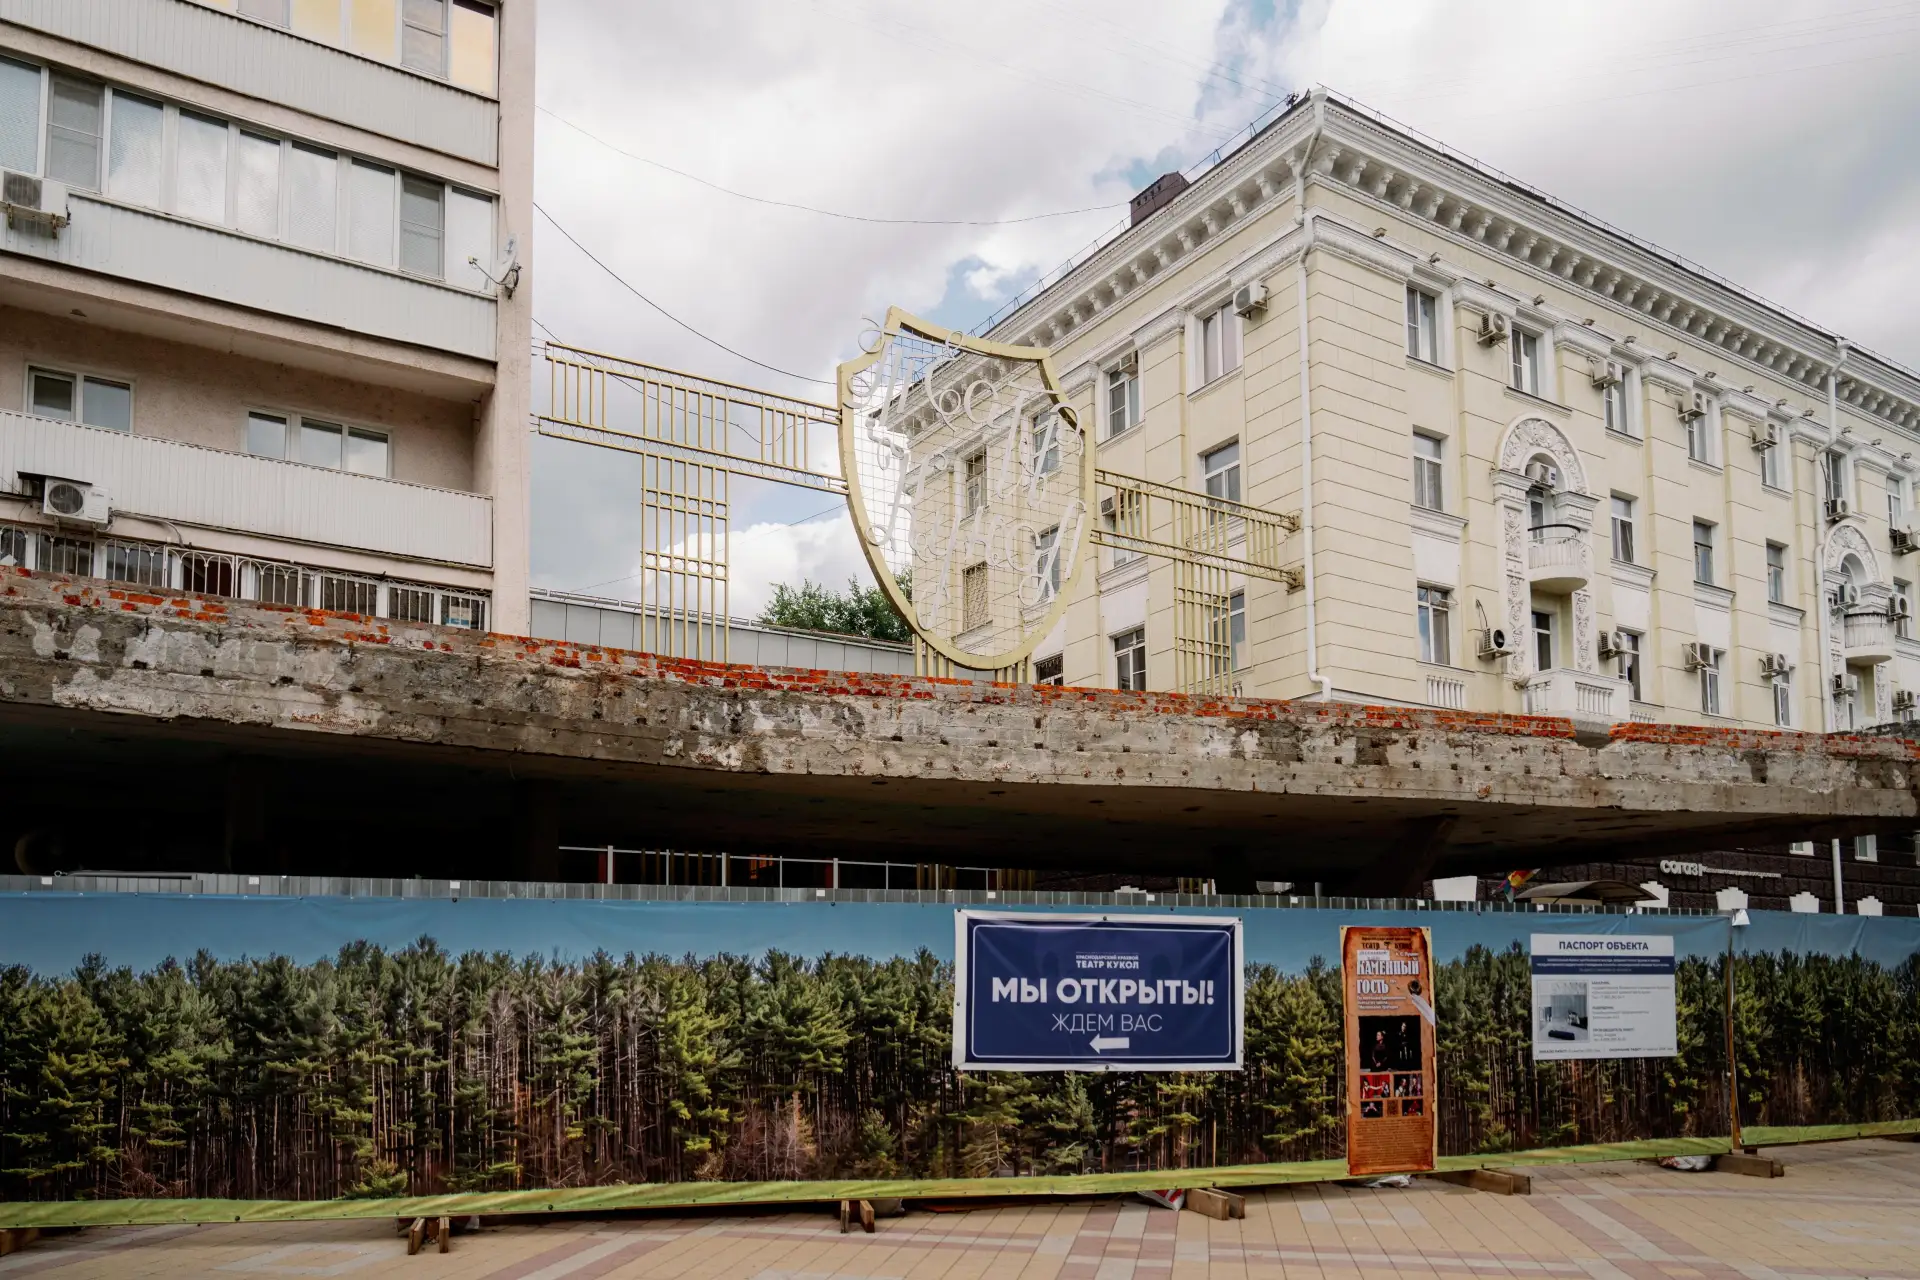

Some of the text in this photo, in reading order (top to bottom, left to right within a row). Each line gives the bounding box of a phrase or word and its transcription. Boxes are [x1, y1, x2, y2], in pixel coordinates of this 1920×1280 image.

[1559, 941, 1649, 950] ПАСПОРТ ОБЪЕКТА
[1076, 960, 1139, 970] ТЕАТР КУКОЛ
[1357, 957, 1419, 975] КАМЕННЫЙ
[992, 977, 1215, 1005] МЫ ОТКРЫТЫ!
[1357, 980, 1389, 994] ГОСТЬ
[1051, 1013, 1163, 1034] ЖДЕМ ВАС
